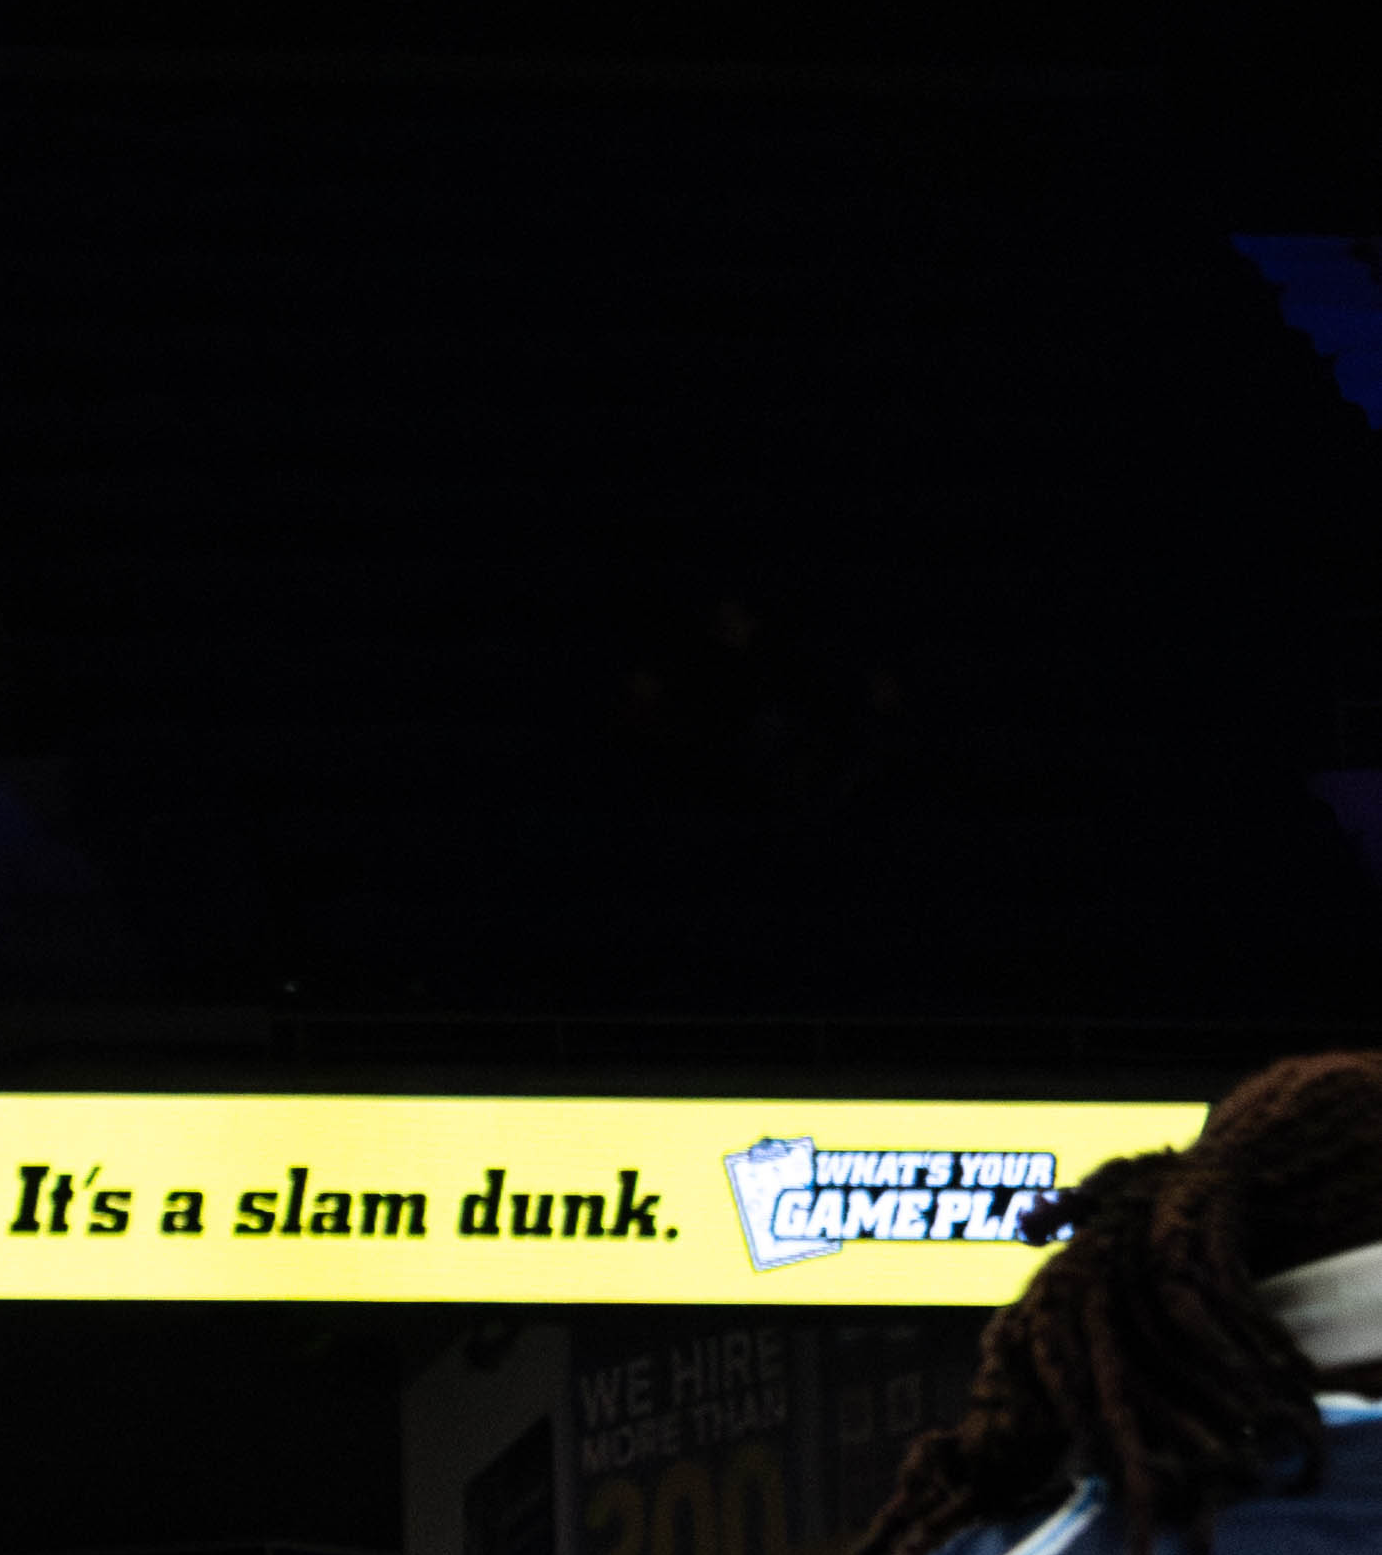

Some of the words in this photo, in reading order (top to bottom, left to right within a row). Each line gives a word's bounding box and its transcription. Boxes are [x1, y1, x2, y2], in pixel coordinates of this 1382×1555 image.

[10, 1165, 133, 1235] It's
[160, 1190, 205, 1235] a
[233, 1167, 428, 1238] slam
[458, 1168, 679, 1239] dunk.
[815, 1152, 954, 1187] WHAT'S
[960, 1152, 1055, 1188] YOUR
[774, 1189, 937, 1241] GAME
[580, 1357, 654, 1428] WE
[671, 1327, 785, 1406] HIRE
[580, 1412, 683, 1475] MORE
[690, 1388, 786, 1444] THAN
